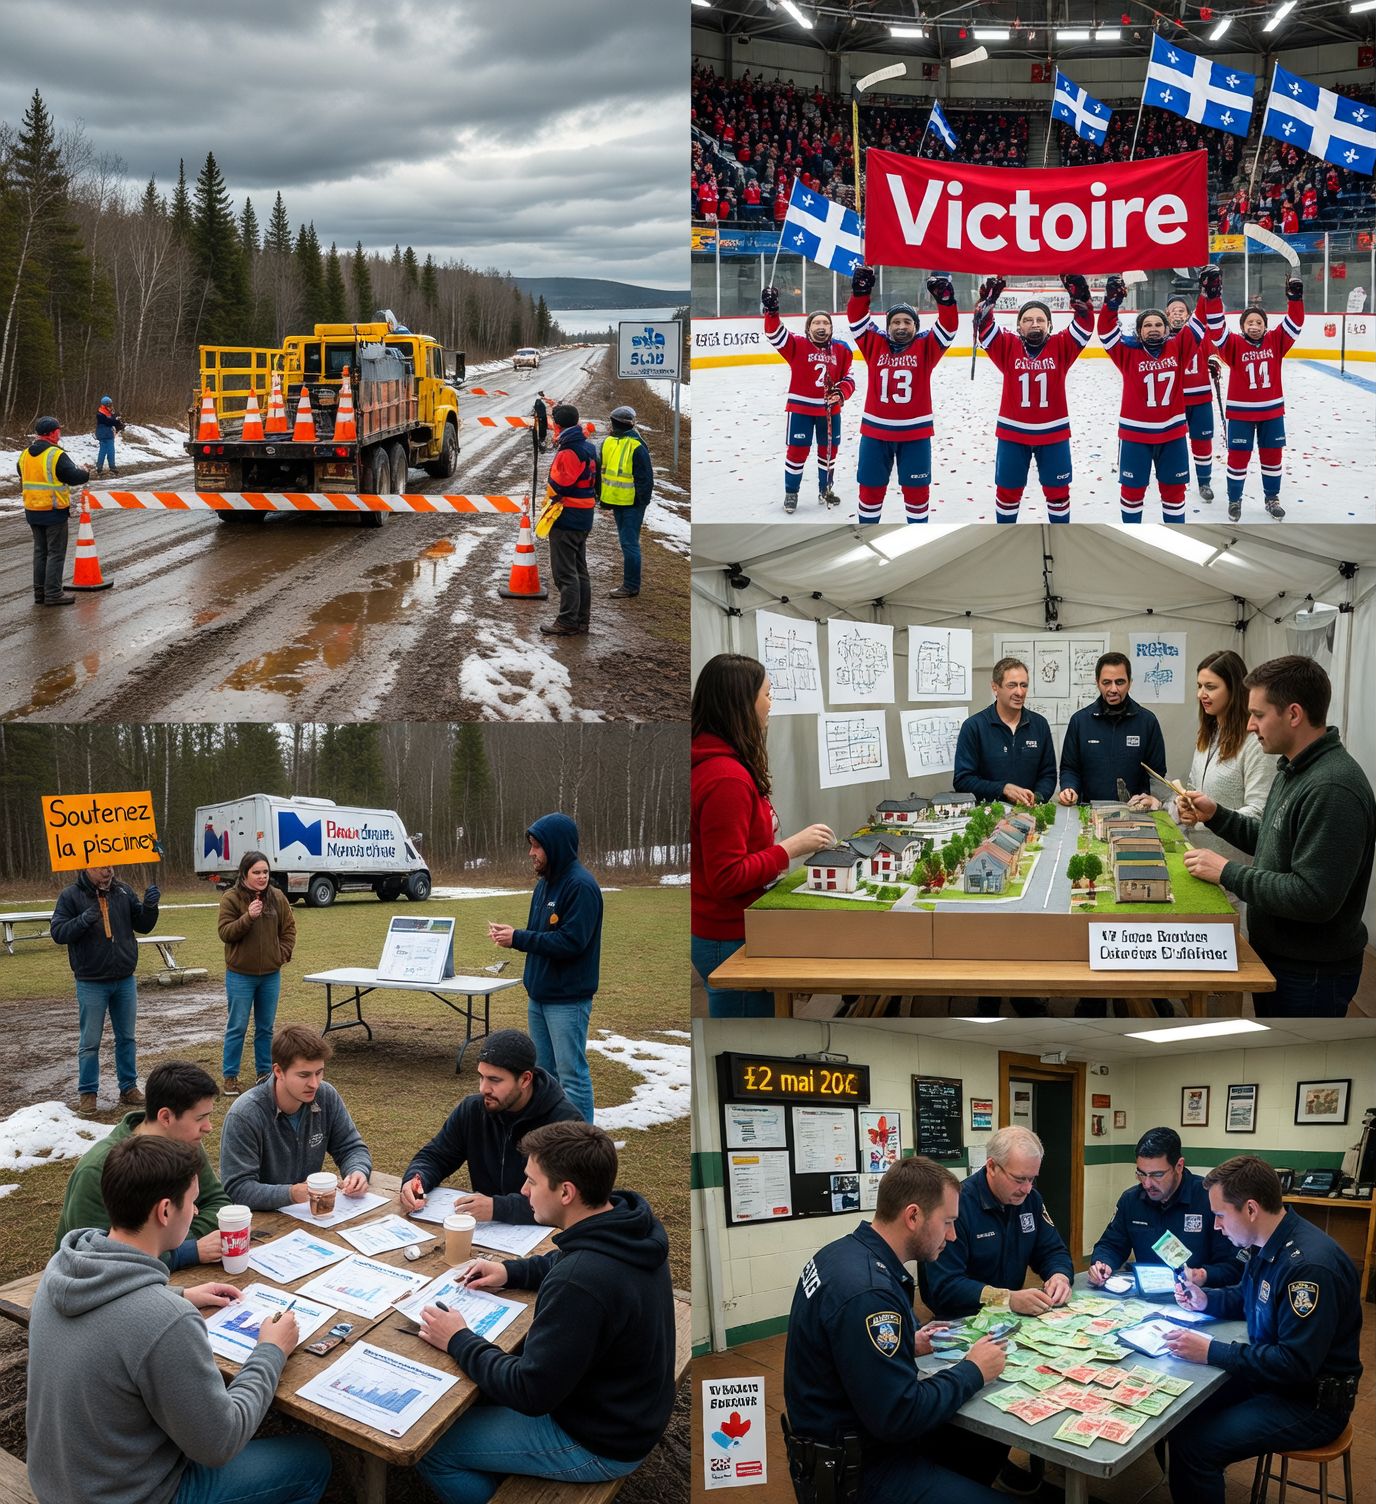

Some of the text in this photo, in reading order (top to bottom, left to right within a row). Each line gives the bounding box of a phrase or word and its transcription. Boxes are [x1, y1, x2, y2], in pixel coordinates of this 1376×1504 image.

[886, 173, 1188, 252] Victoire
[879, 368, 913, 404] 13
[1018, 372, 1049, 408] 11
[1143, 370, 1176, 408] 17
[49, 799, 151, 828] Soutenez
[56, 834, 77, 859] la
[780, 1069, 814, 1093] mai
